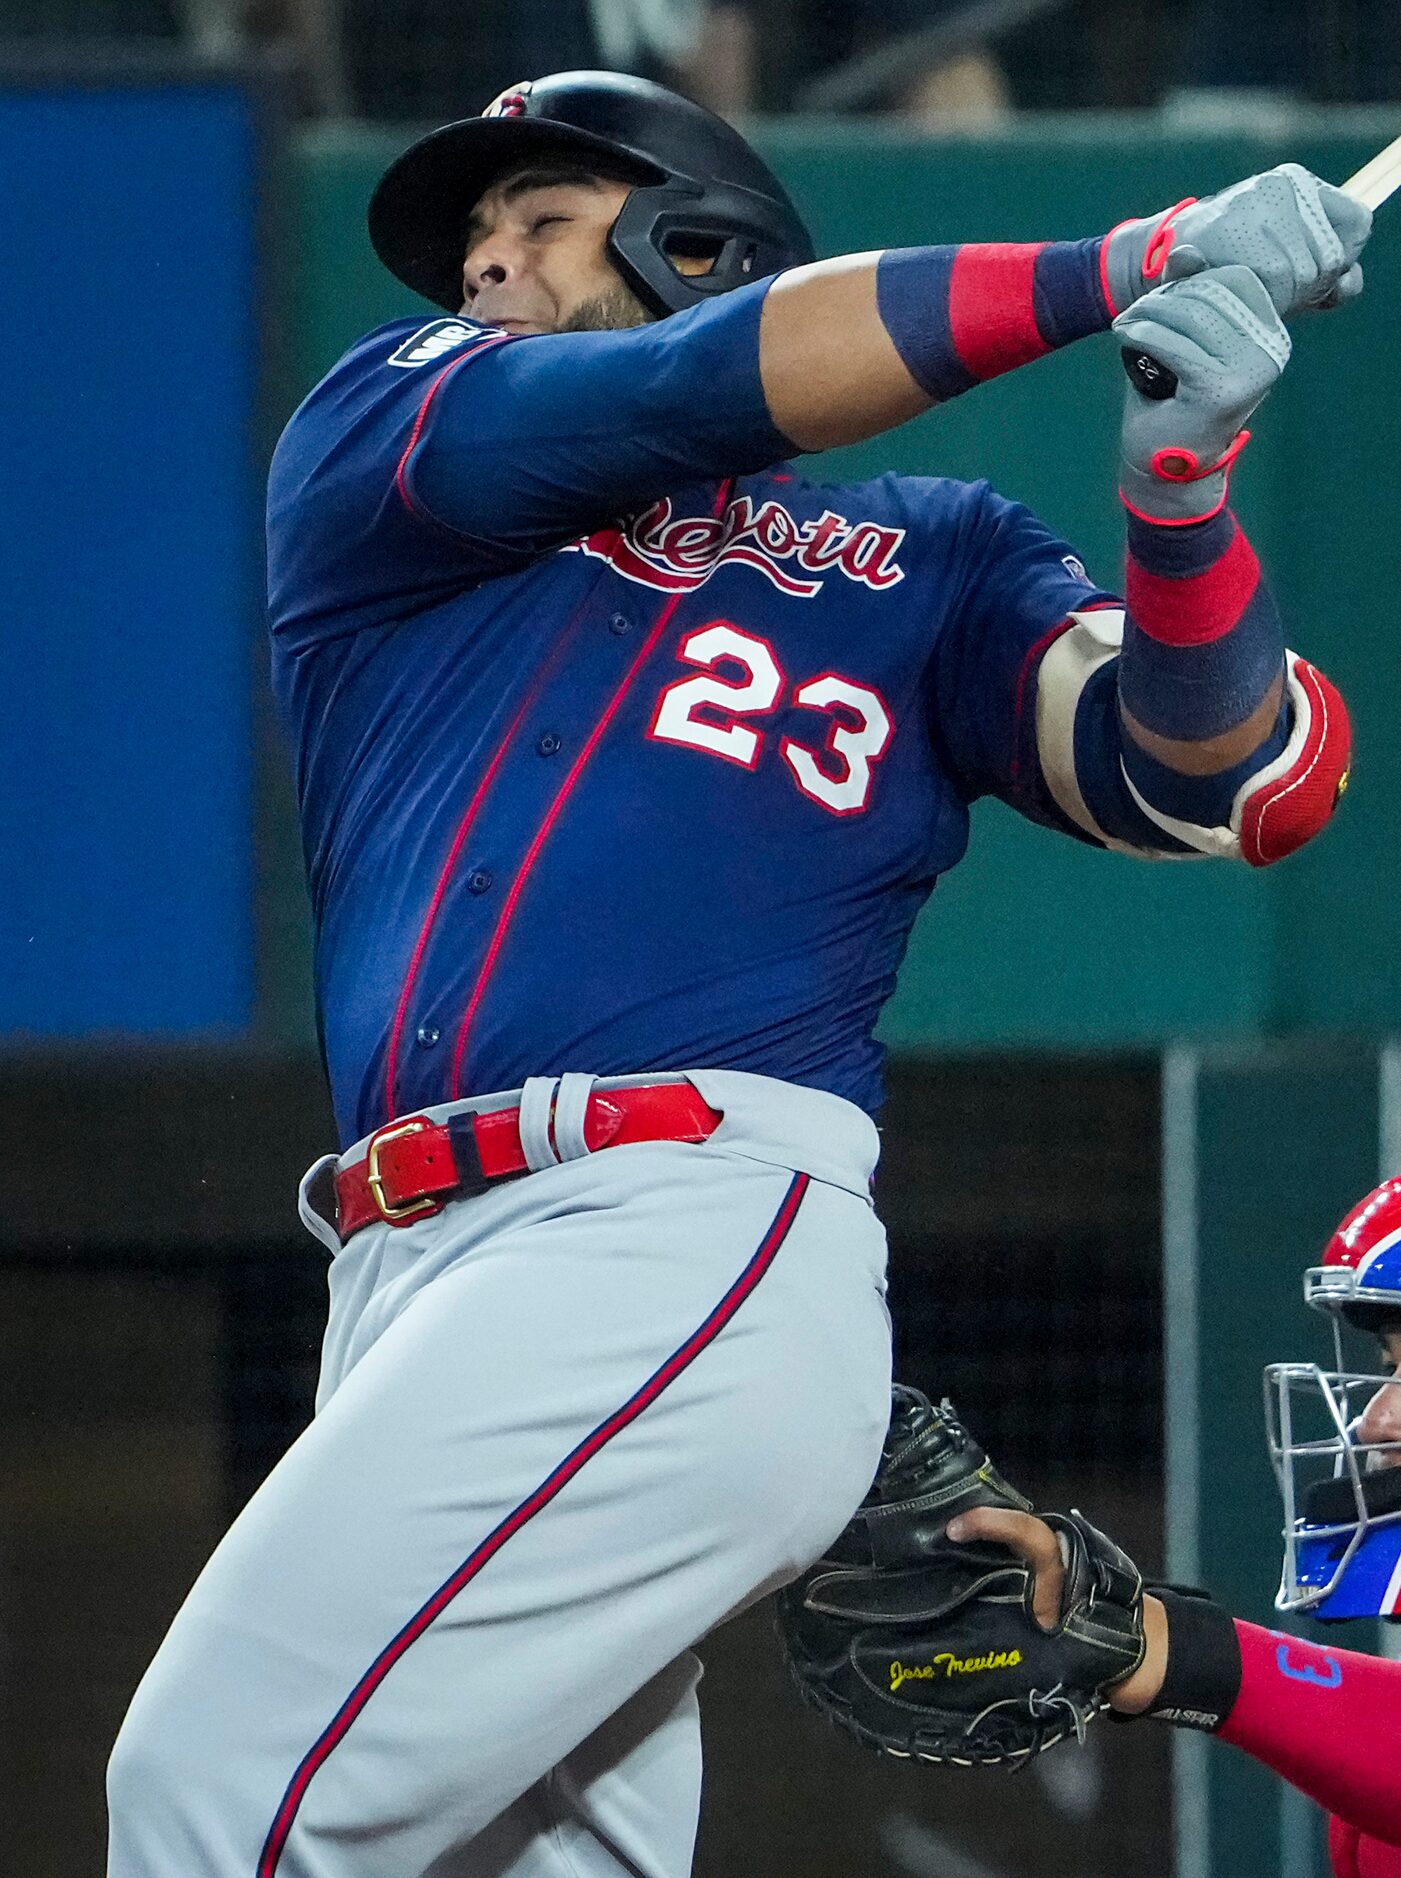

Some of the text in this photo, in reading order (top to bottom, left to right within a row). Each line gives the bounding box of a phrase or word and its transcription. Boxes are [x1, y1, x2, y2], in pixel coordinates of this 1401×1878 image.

[646, 618, 895, 816] 23
[890, 1649, 1023, 1691] Jose Trevino
[1274, 1630, 1343, 1689] 3
